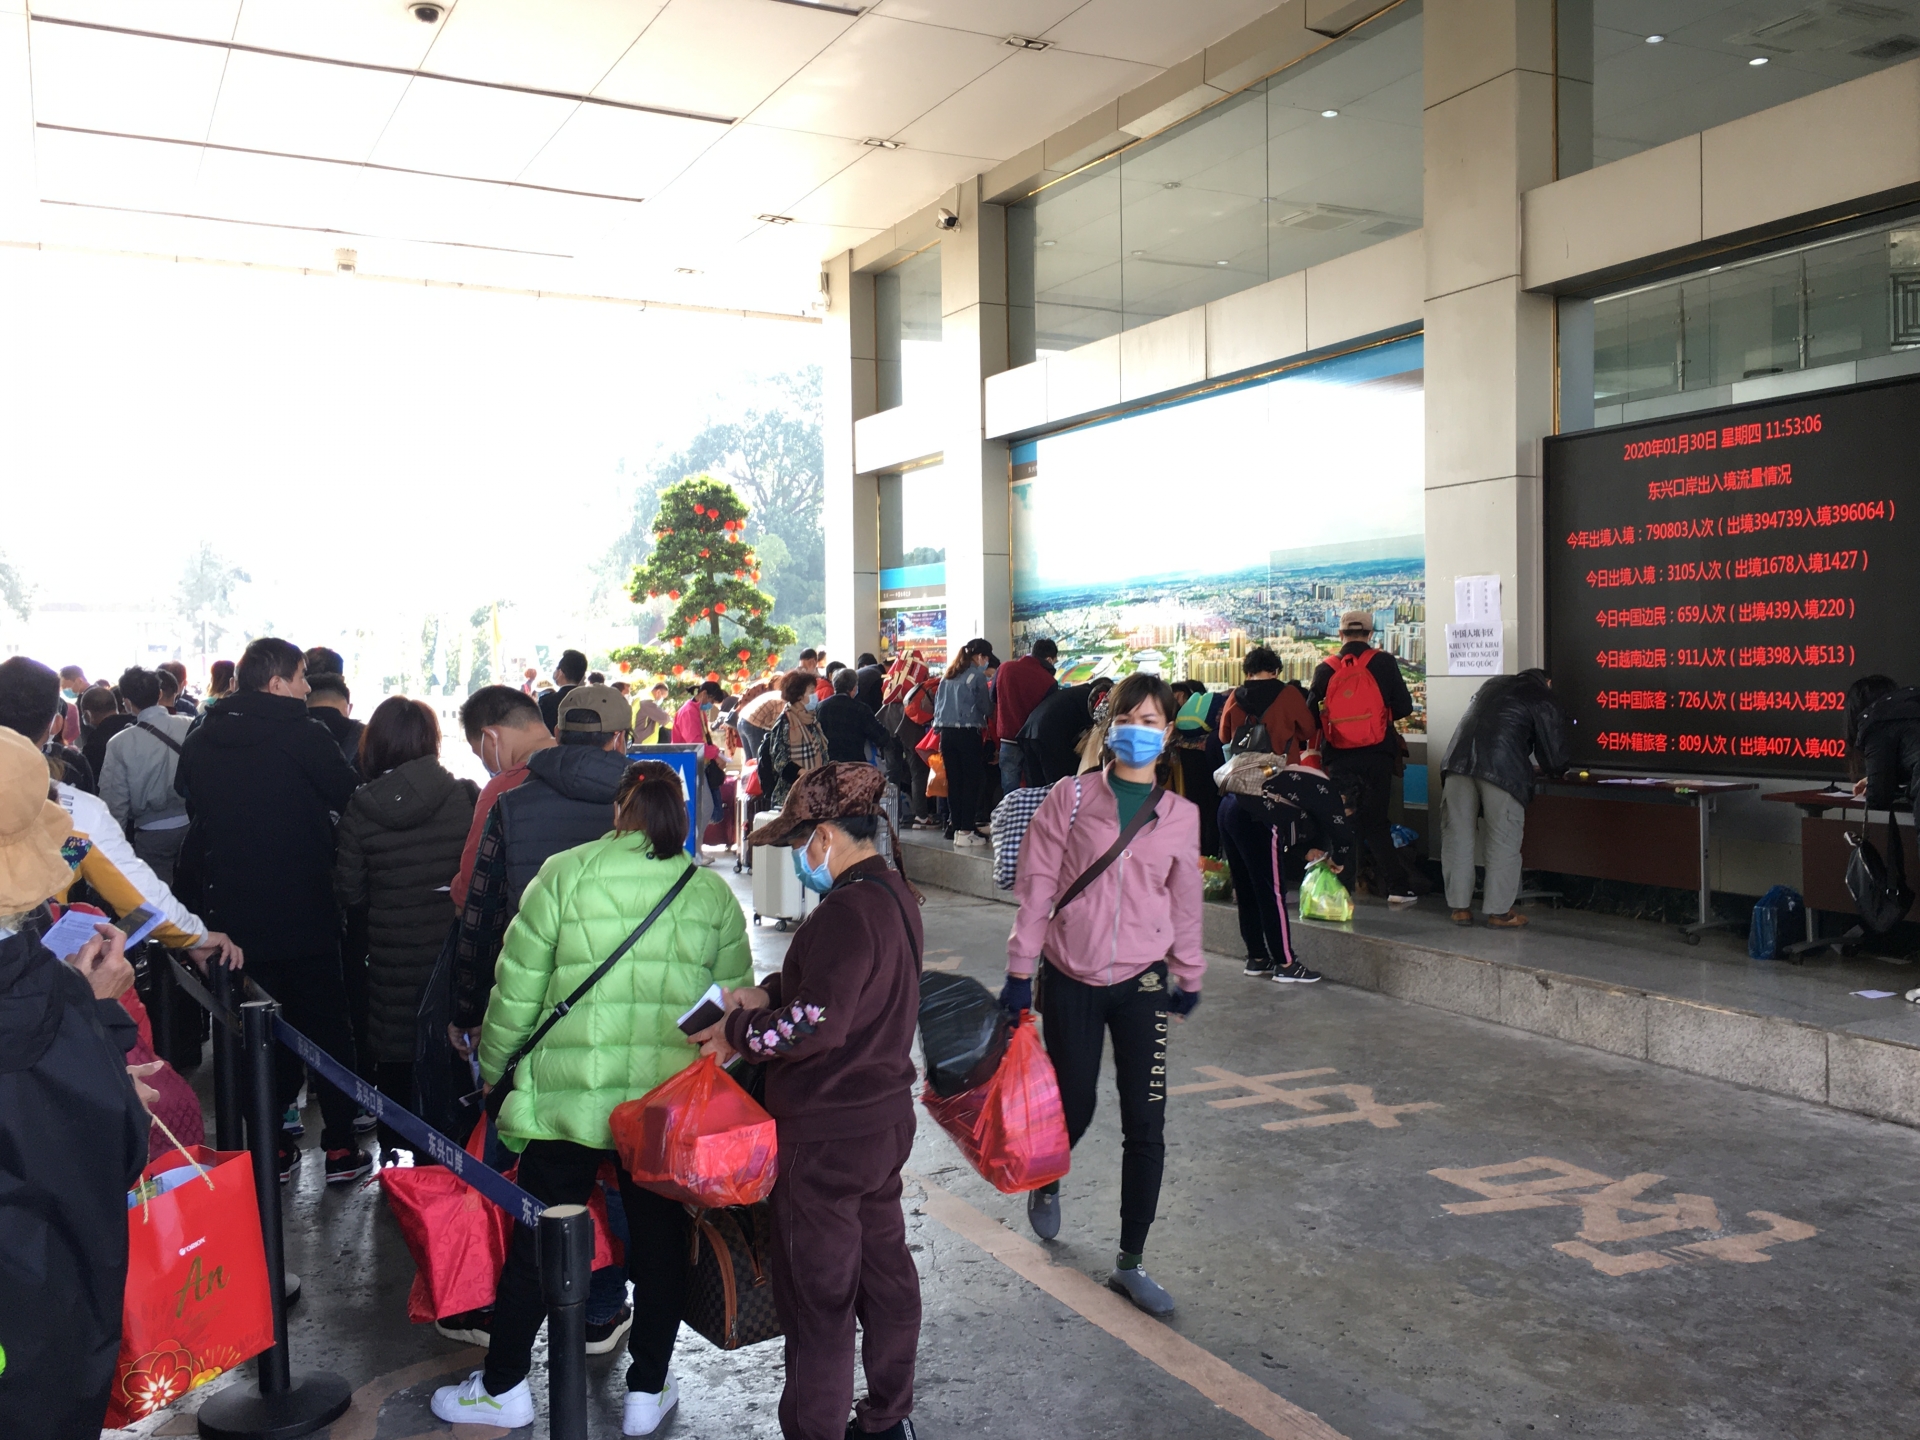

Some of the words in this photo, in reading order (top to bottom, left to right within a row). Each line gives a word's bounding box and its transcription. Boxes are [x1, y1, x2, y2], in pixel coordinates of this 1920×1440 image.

[1623, 430, 1717, 461] 2020年01月30日
[1720, 425, 1762, 449] 星期四
[1765, 414, 1823, 440] 11:53:06
[1648, 463, 1793, 501] 东兴口岸出入境流量情况
[427, 1132, 463, 1175] 东兴口岸
[173, 1255, 231, 1319] An
